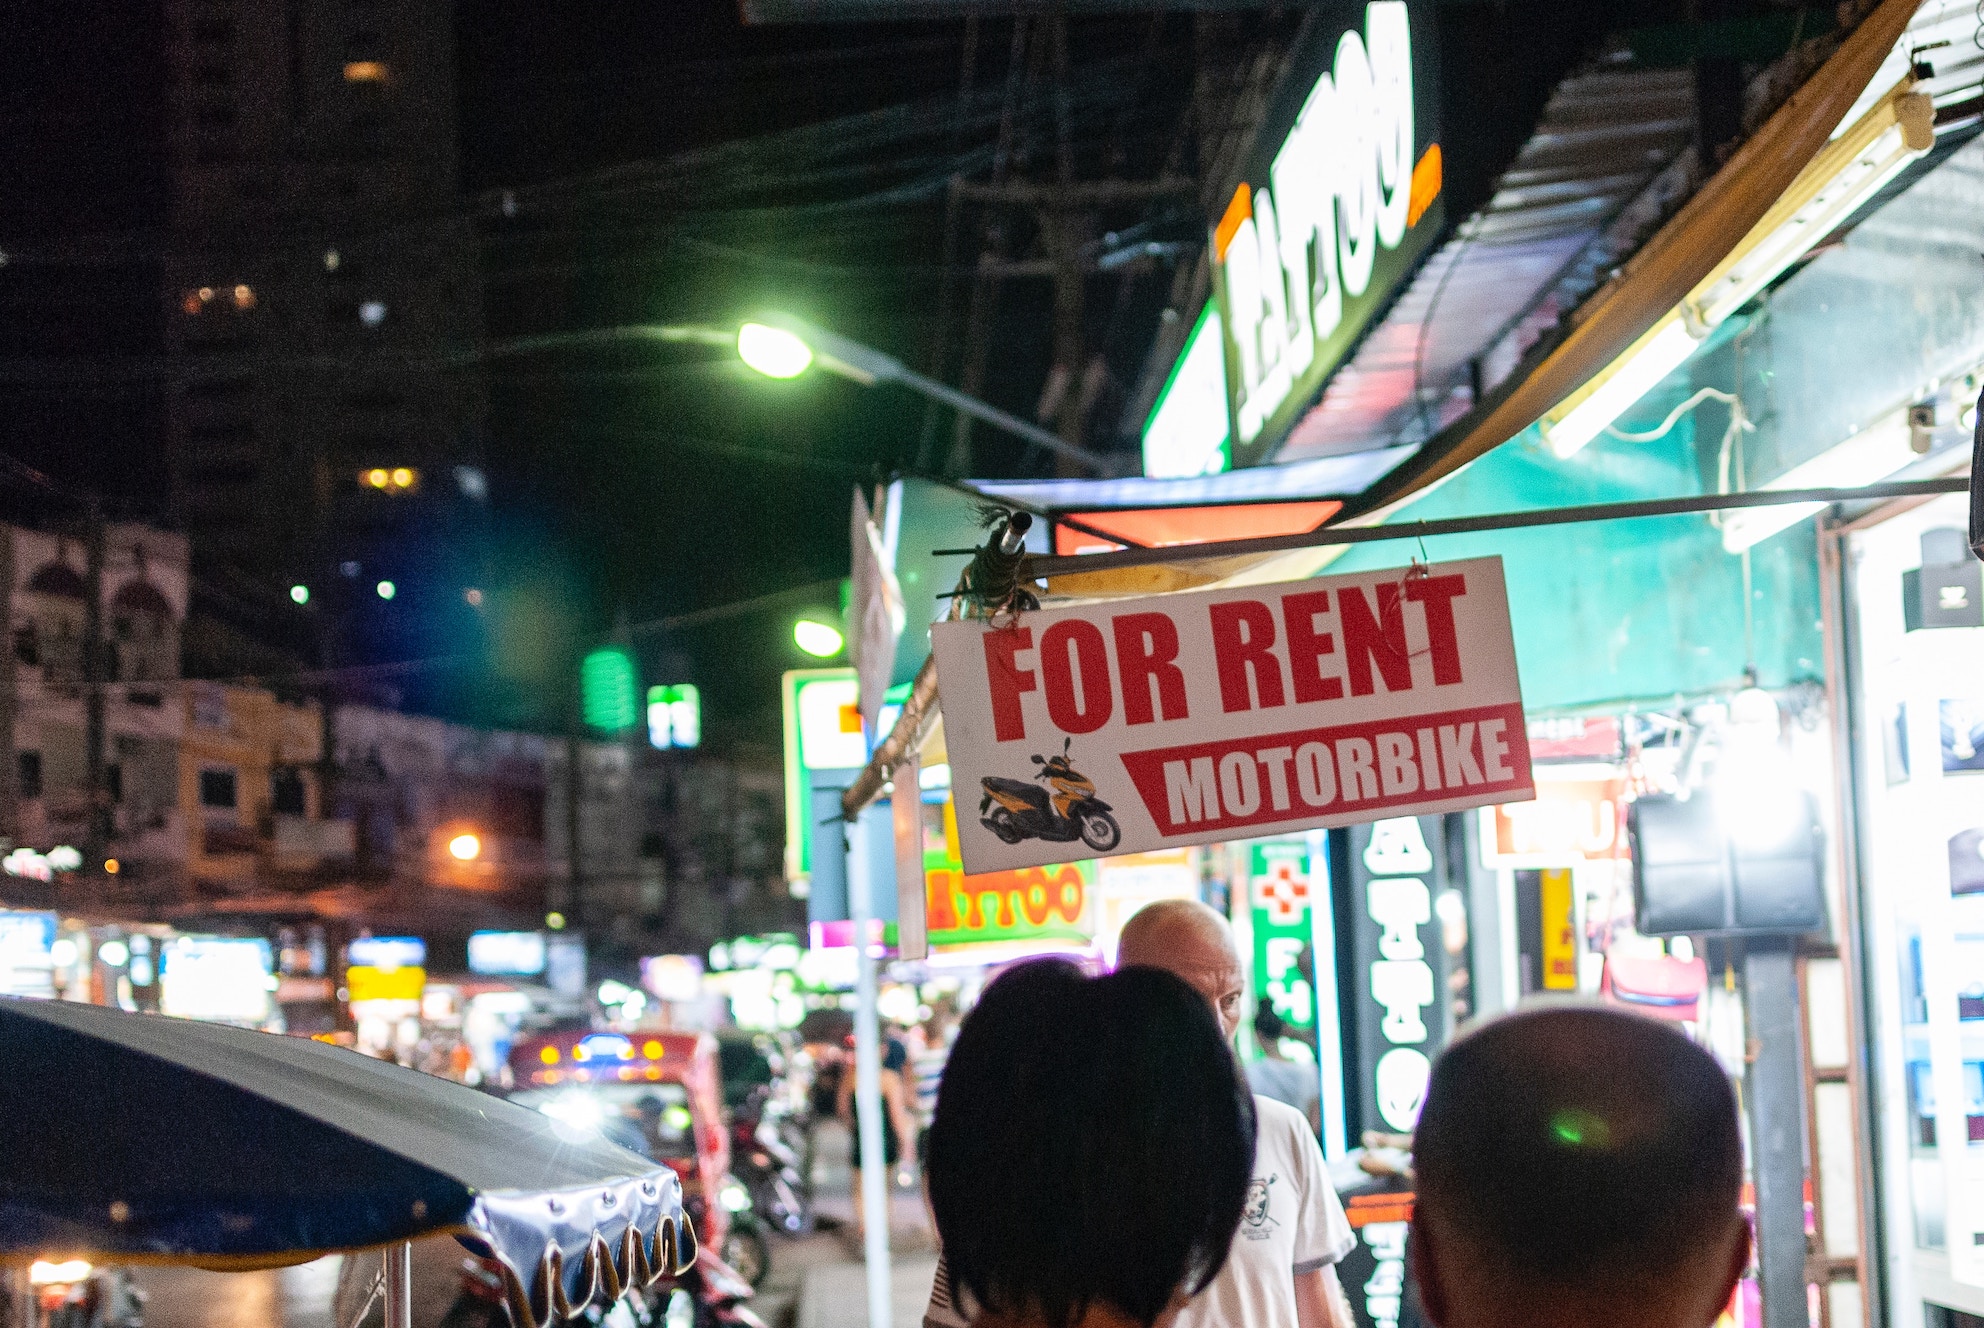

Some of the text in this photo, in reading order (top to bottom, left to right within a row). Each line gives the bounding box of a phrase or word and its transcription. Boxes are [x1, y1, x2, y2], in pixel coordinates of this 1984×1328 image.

[983, 573, 1466, 742] FOR RENT
[1163, 718, 1514, 826] MOTORBIKE
